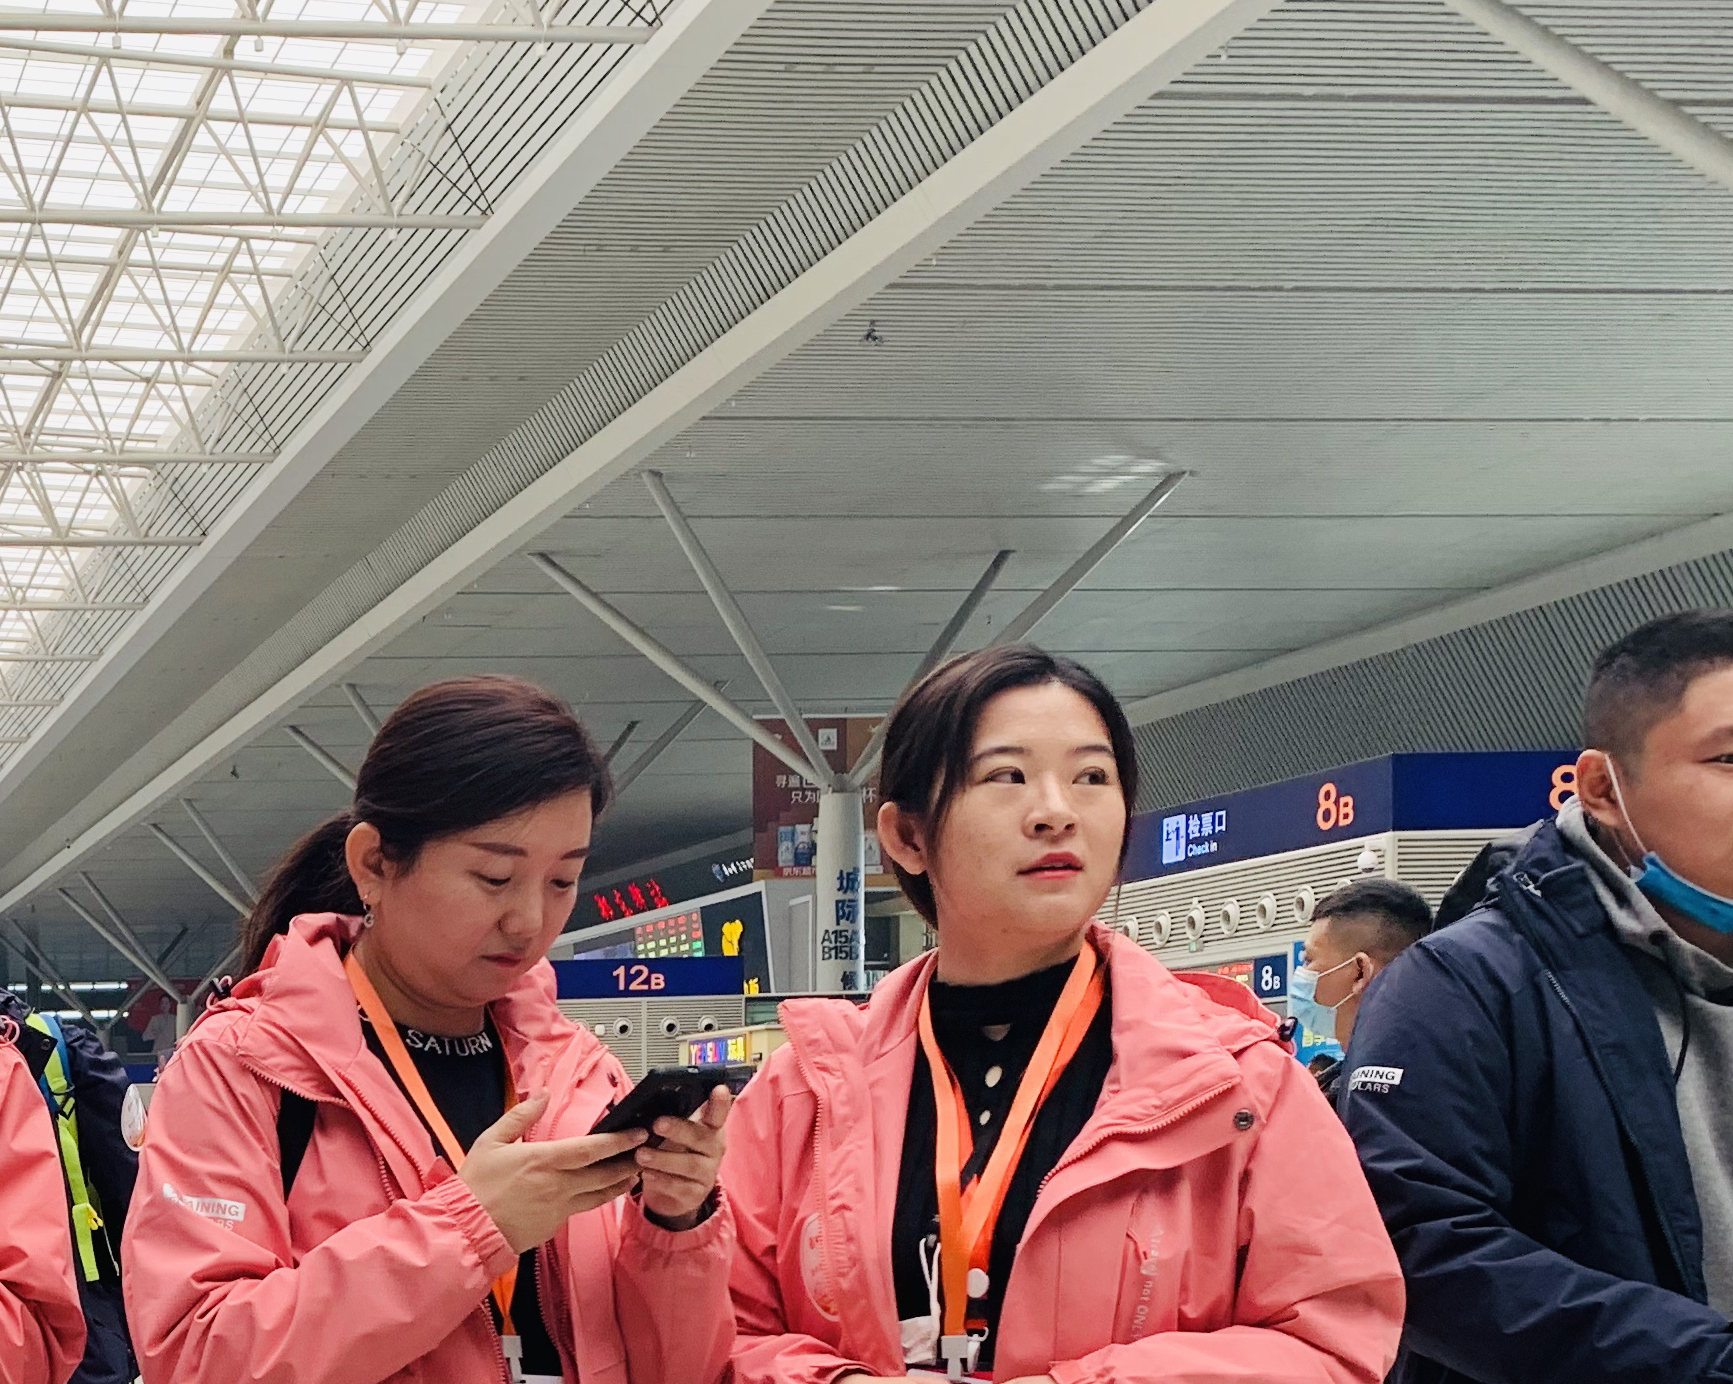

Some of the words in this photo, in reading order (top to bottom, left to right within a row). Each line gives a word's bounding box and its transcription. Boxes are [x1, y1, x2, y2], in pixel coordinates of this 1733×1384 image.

[1316, 782, 1354, 831] 8B
[1187, 810, 1227, 840] 检票口
[1187, 841, 1210, 857] Check
[1210, 841, 1218, 853] in
[612, 964, 666, 992] 12B
[1261, 965, 1281, 991] 8B
[405, 1029, 493, 1057] SATURN
